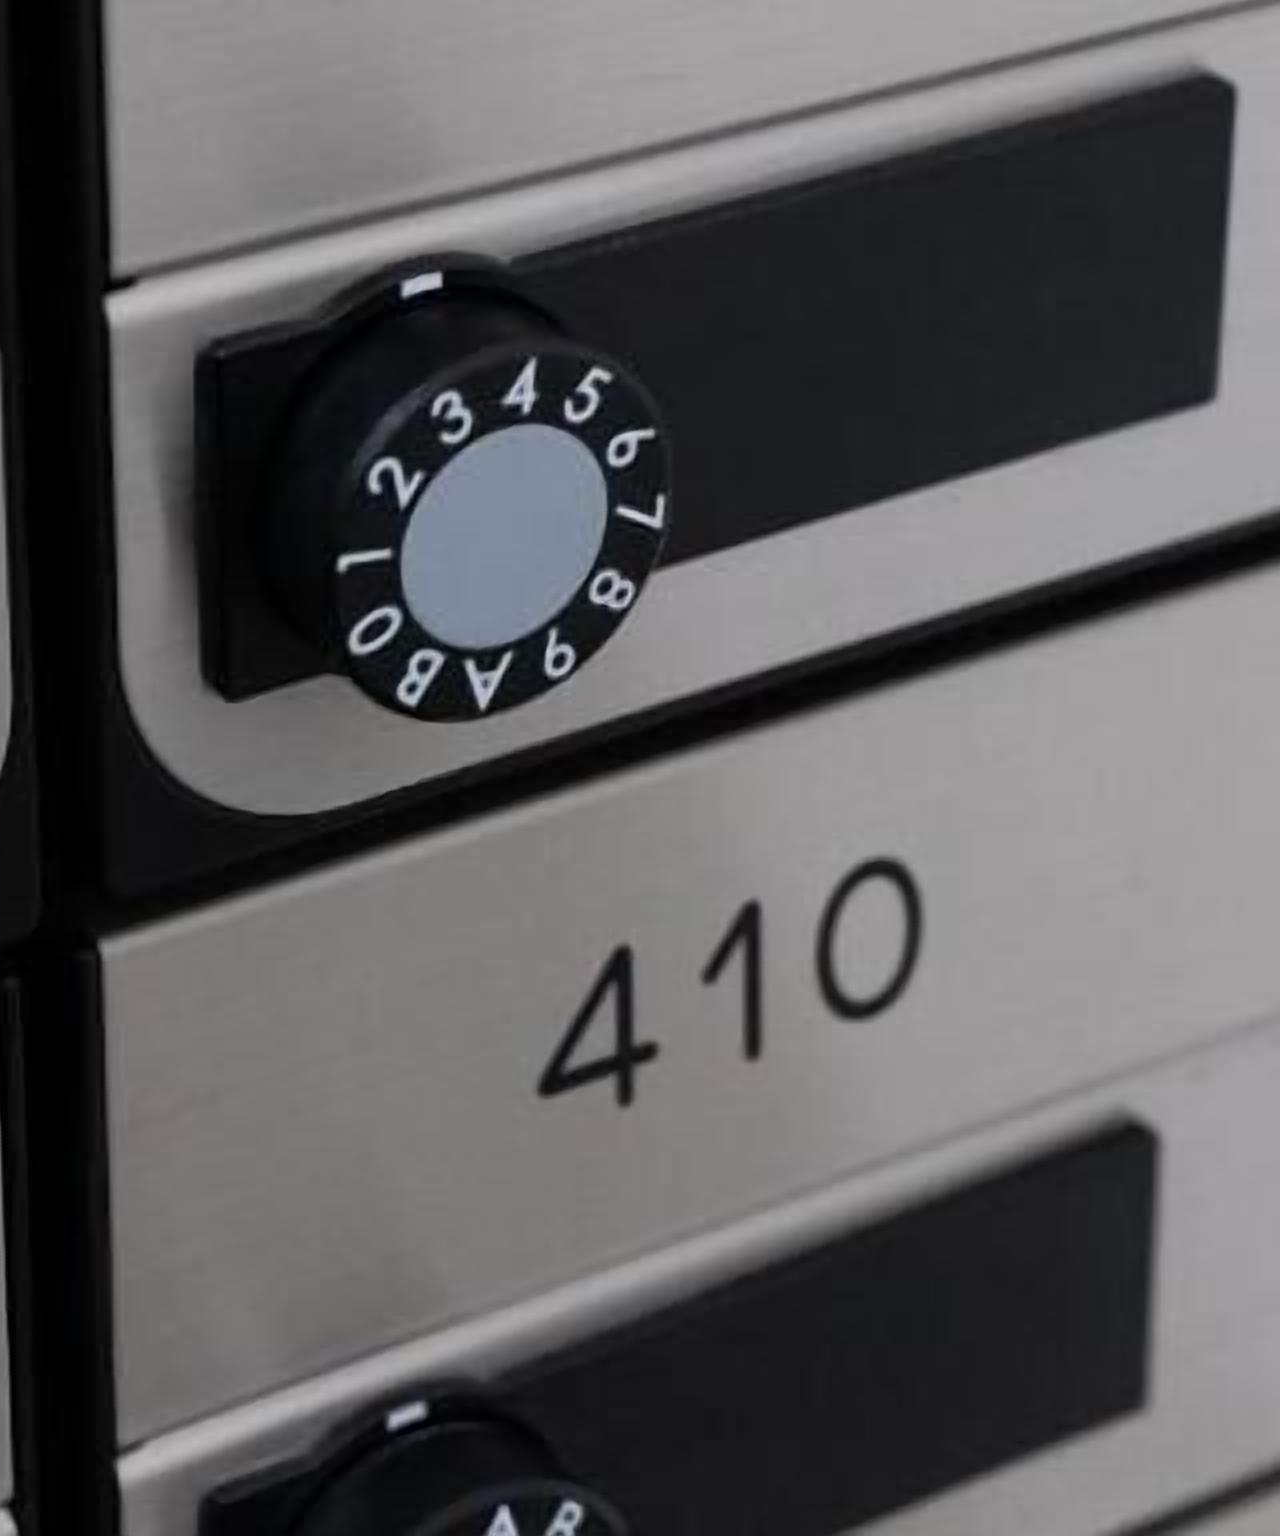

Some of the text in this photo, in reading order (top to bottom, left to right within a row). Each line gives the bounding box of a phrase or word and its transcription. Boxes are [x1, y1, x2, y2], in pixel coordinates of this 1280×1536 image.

[336, 357, 667, 711] 0 1 2 3 4 5 6 7 8 9 A B
[537, 855, 924, 1109] 410
